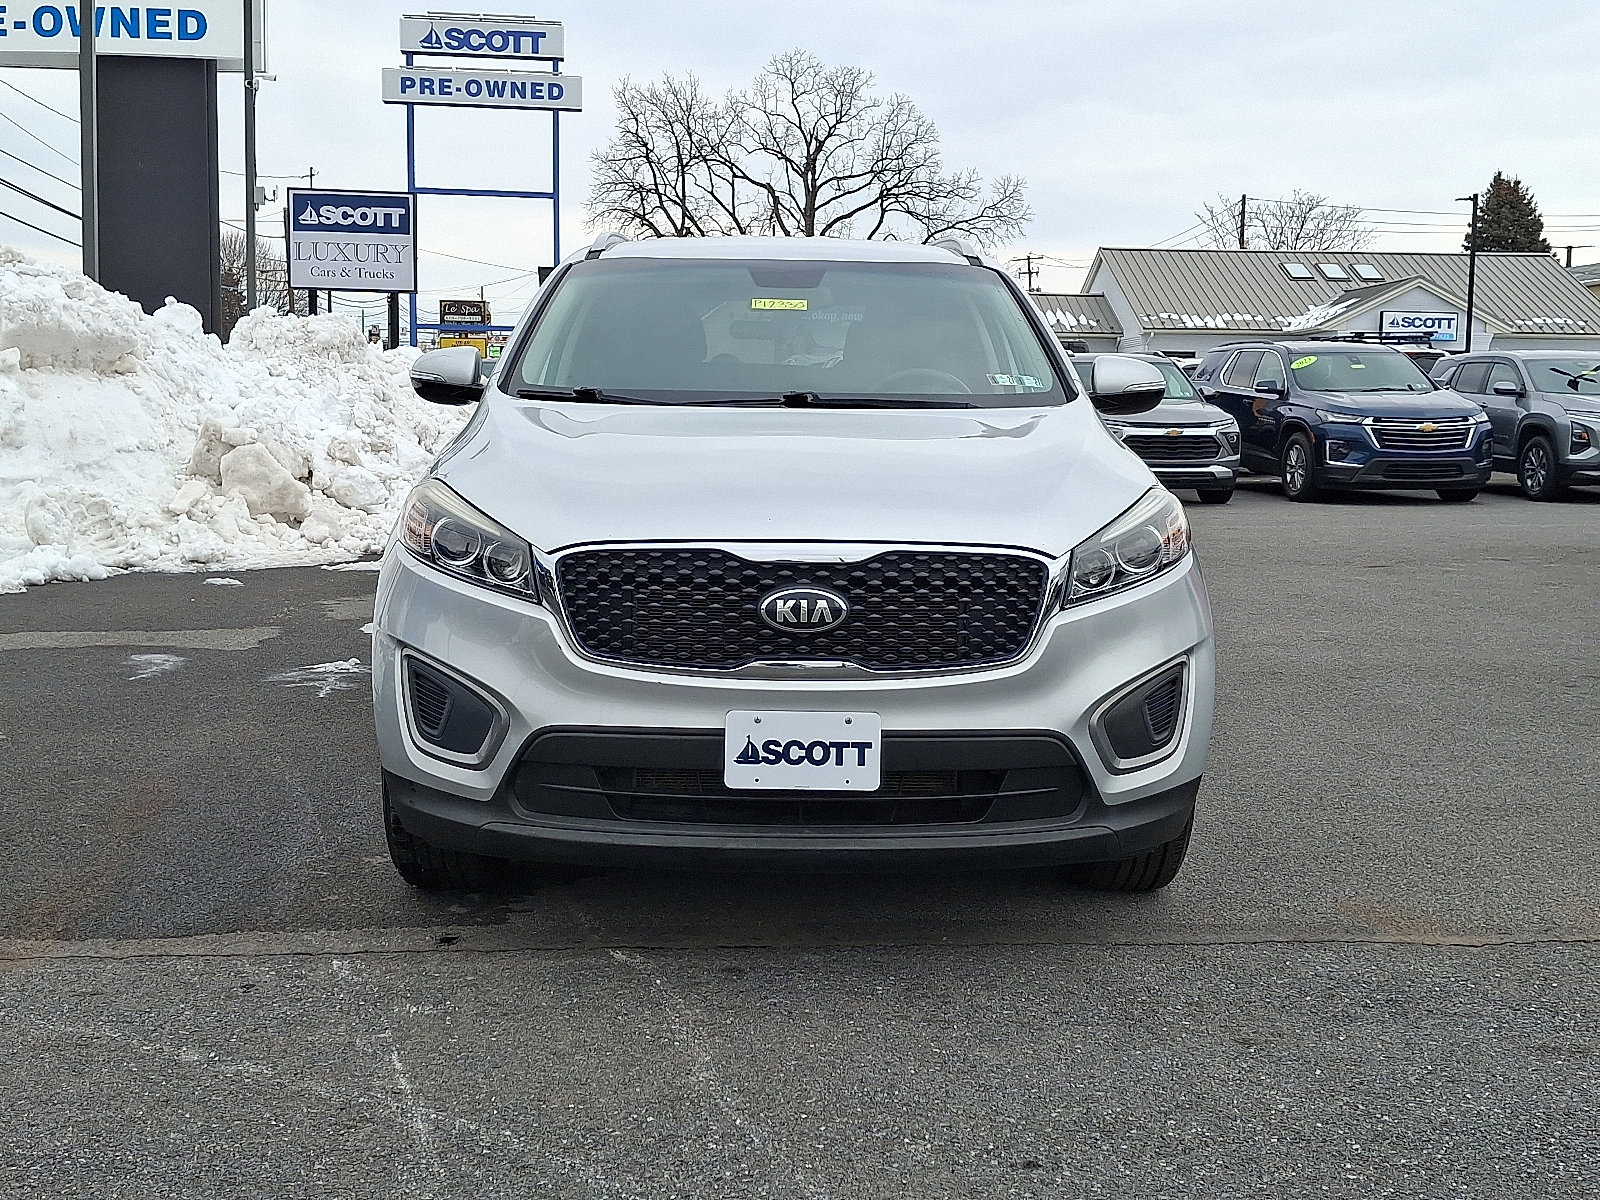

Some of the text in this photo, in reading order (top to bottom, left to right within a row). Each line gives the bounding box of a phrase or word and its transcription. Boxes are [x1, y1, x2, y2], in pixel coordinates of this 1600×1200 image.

[0, 5, 208, 41] -OWNED
[444, 28, 546, 54] SCOTT
[400, 77, 565, 101] PRE-OWNED
[318, 205, 406, 228] SCOTT
[294, 241, 410, 264] LUXURY
[310, 266, 395, 279] Cars & Trucks
[460, 304, 480, 316] Spa
[1401, 316, 1456, 329] SCOTT
[775, 599, 833, 623] KIA
[761, 739, 873, 767] SCOTT
